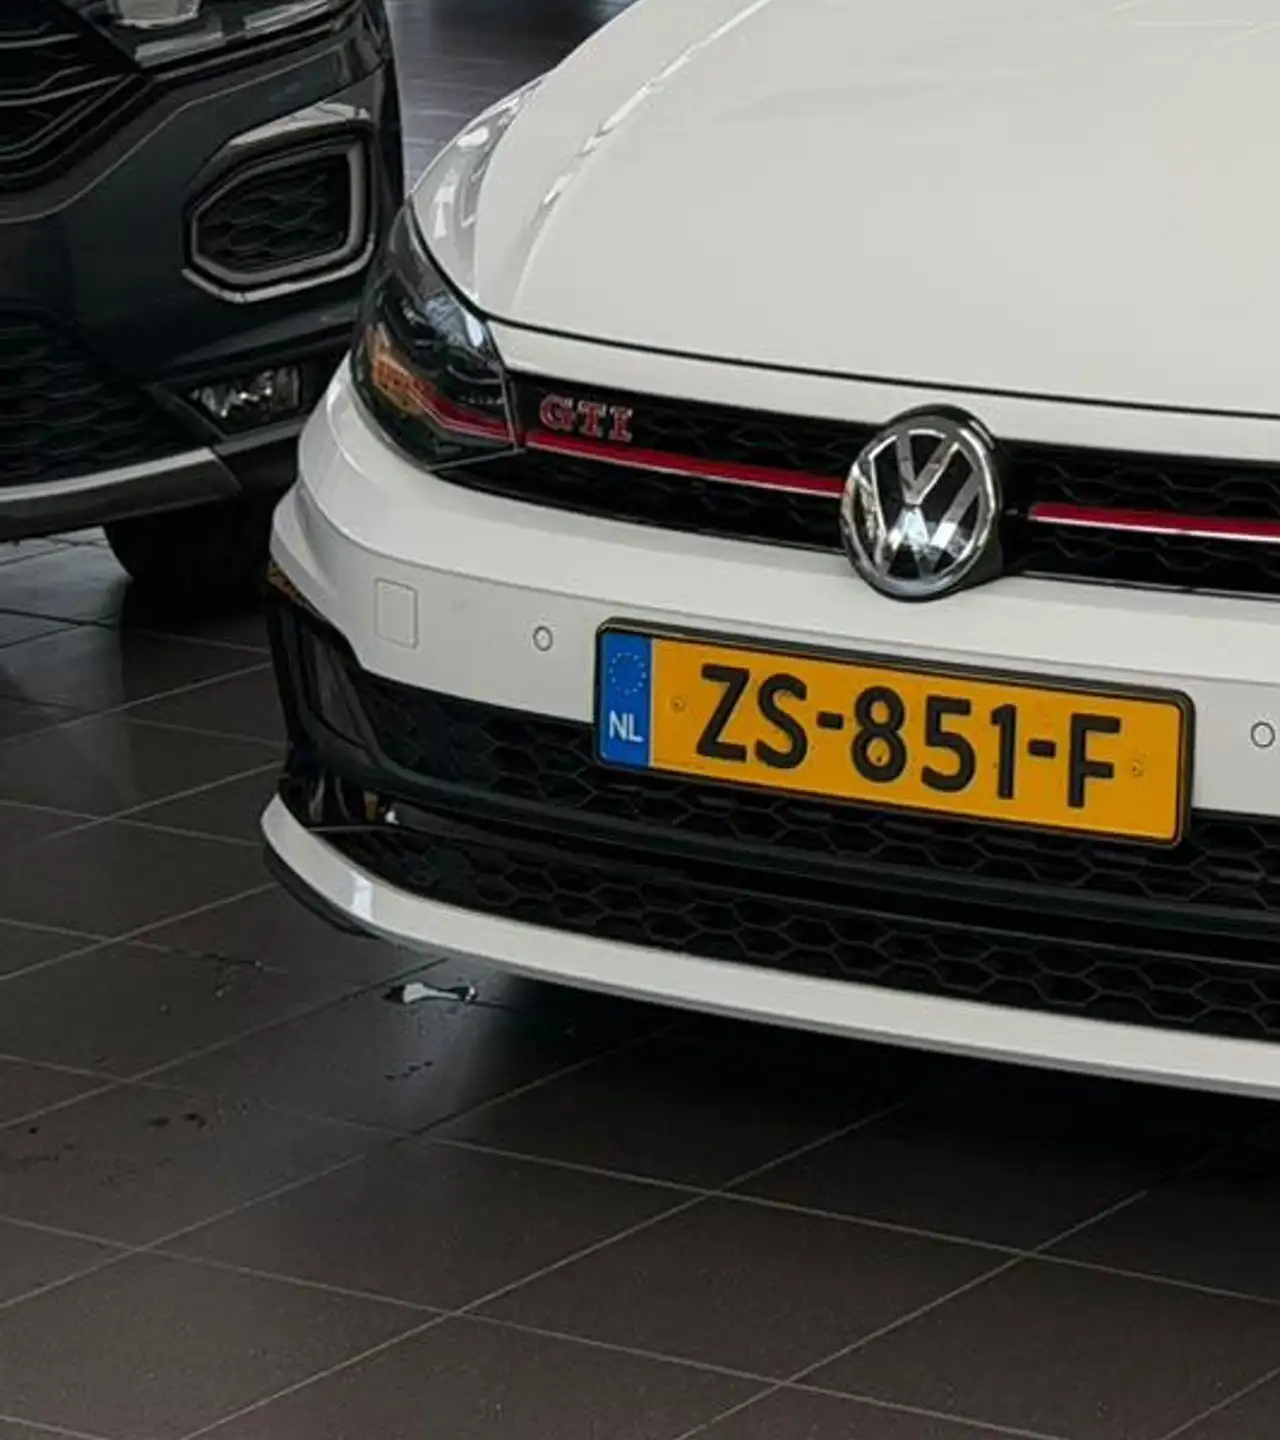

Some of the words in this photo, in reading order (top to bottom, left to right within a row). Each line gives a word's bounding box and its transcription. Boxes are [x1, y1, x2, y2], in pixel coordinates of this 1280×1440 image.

[540, 394, 633, 442] GTI
[609, 710, 644, 743] NL
[696, 662, 1122, 808] ZS-851-F
